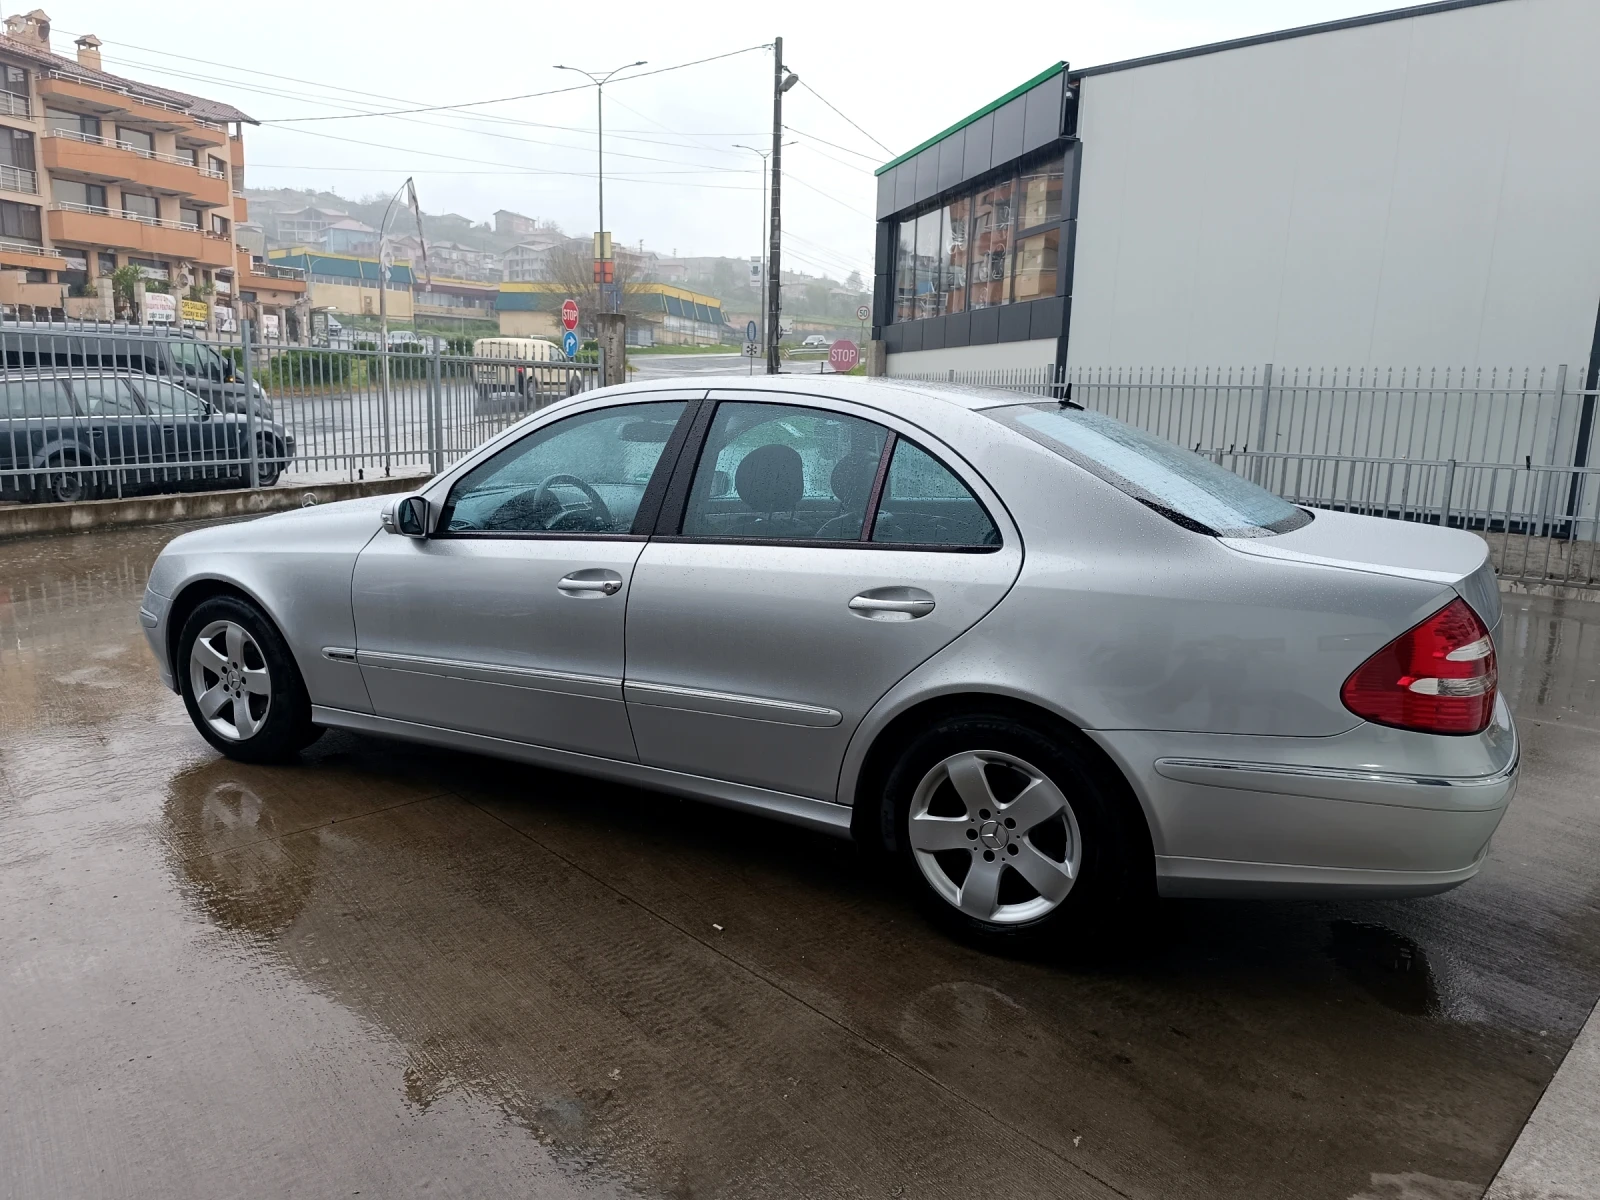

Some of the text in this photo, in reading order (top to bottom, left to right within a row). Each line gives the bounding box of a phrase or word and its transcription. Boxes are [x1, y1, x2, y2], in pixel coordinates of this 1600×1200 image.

[563, 309, 577, 321] STOP
[859, 309, 867, 317] 50
[831, 349, 856, 362] STOP
